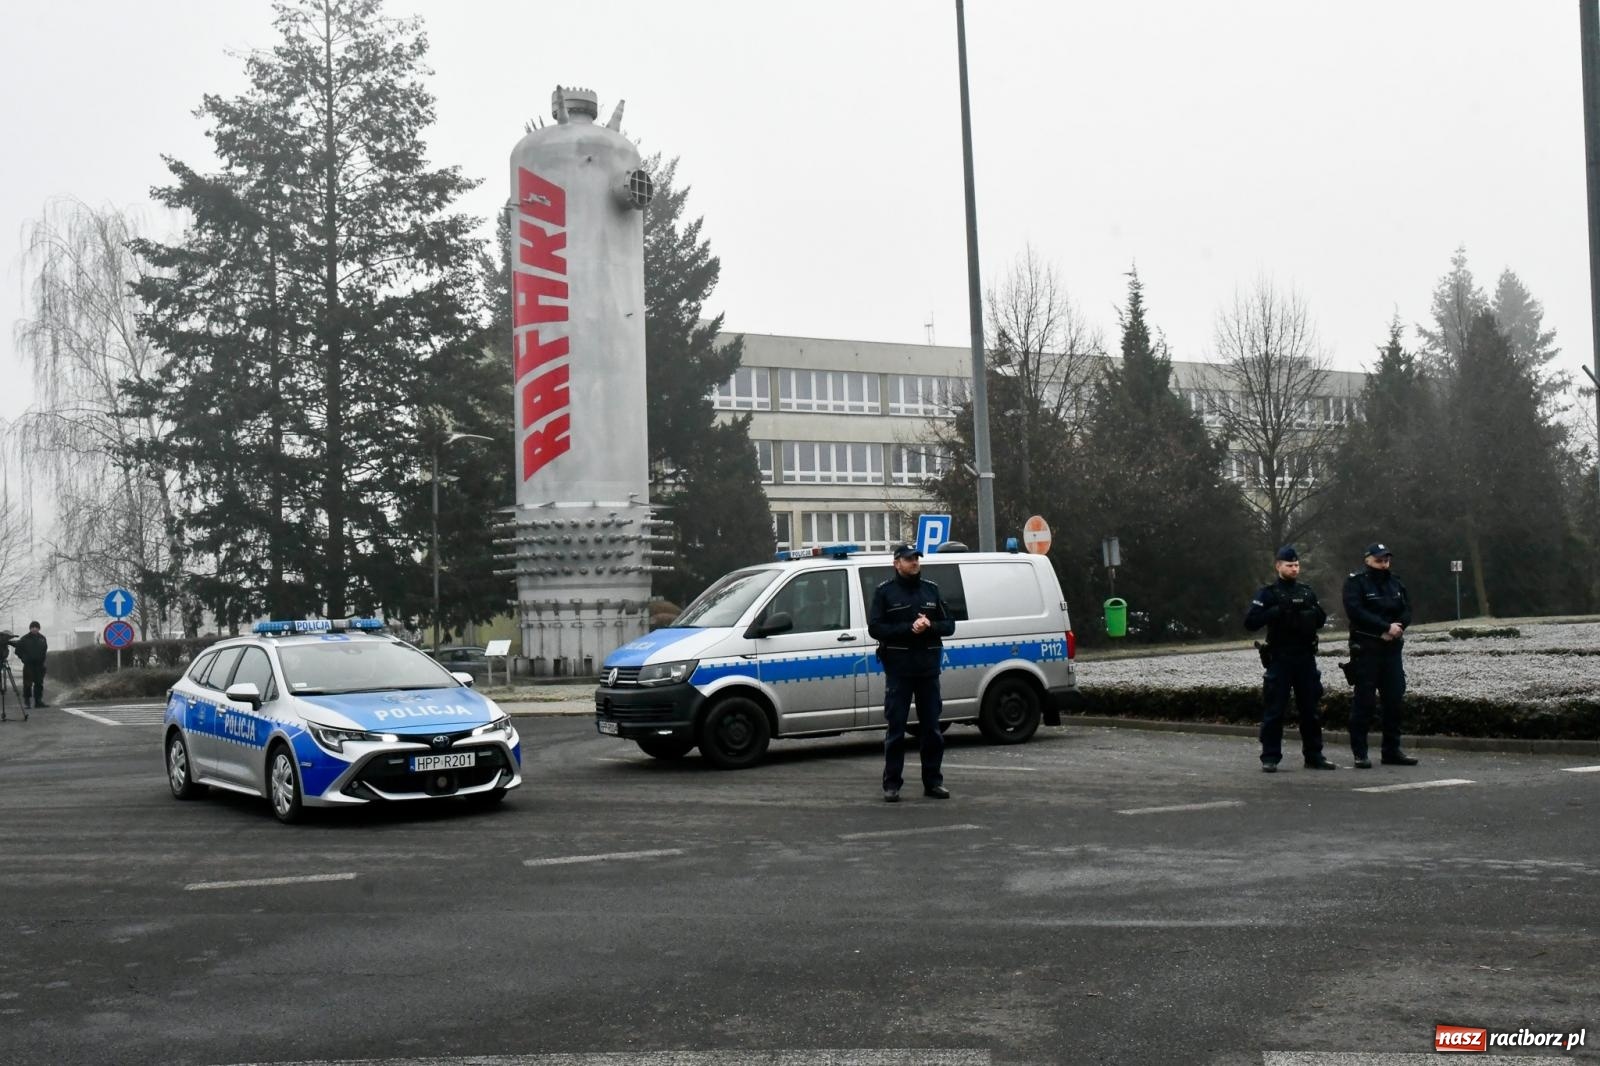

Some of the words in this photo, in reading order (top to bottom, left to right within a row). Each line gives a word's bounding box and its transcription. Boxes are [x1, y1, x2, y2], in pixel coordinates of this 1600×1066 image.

[513, 166, 571, 482] RAFAKO
[924, 520, 943, 553] P
[296, 620, 330, 631] POLICJA
[1041, 643, 1063, 657] P112
[374, 704, 473, 721] POLICJA
[224, 713, 256, 742] POLICJA
[417, 757, 441, 770] HPP
[444, 755, 472, 768] R201
